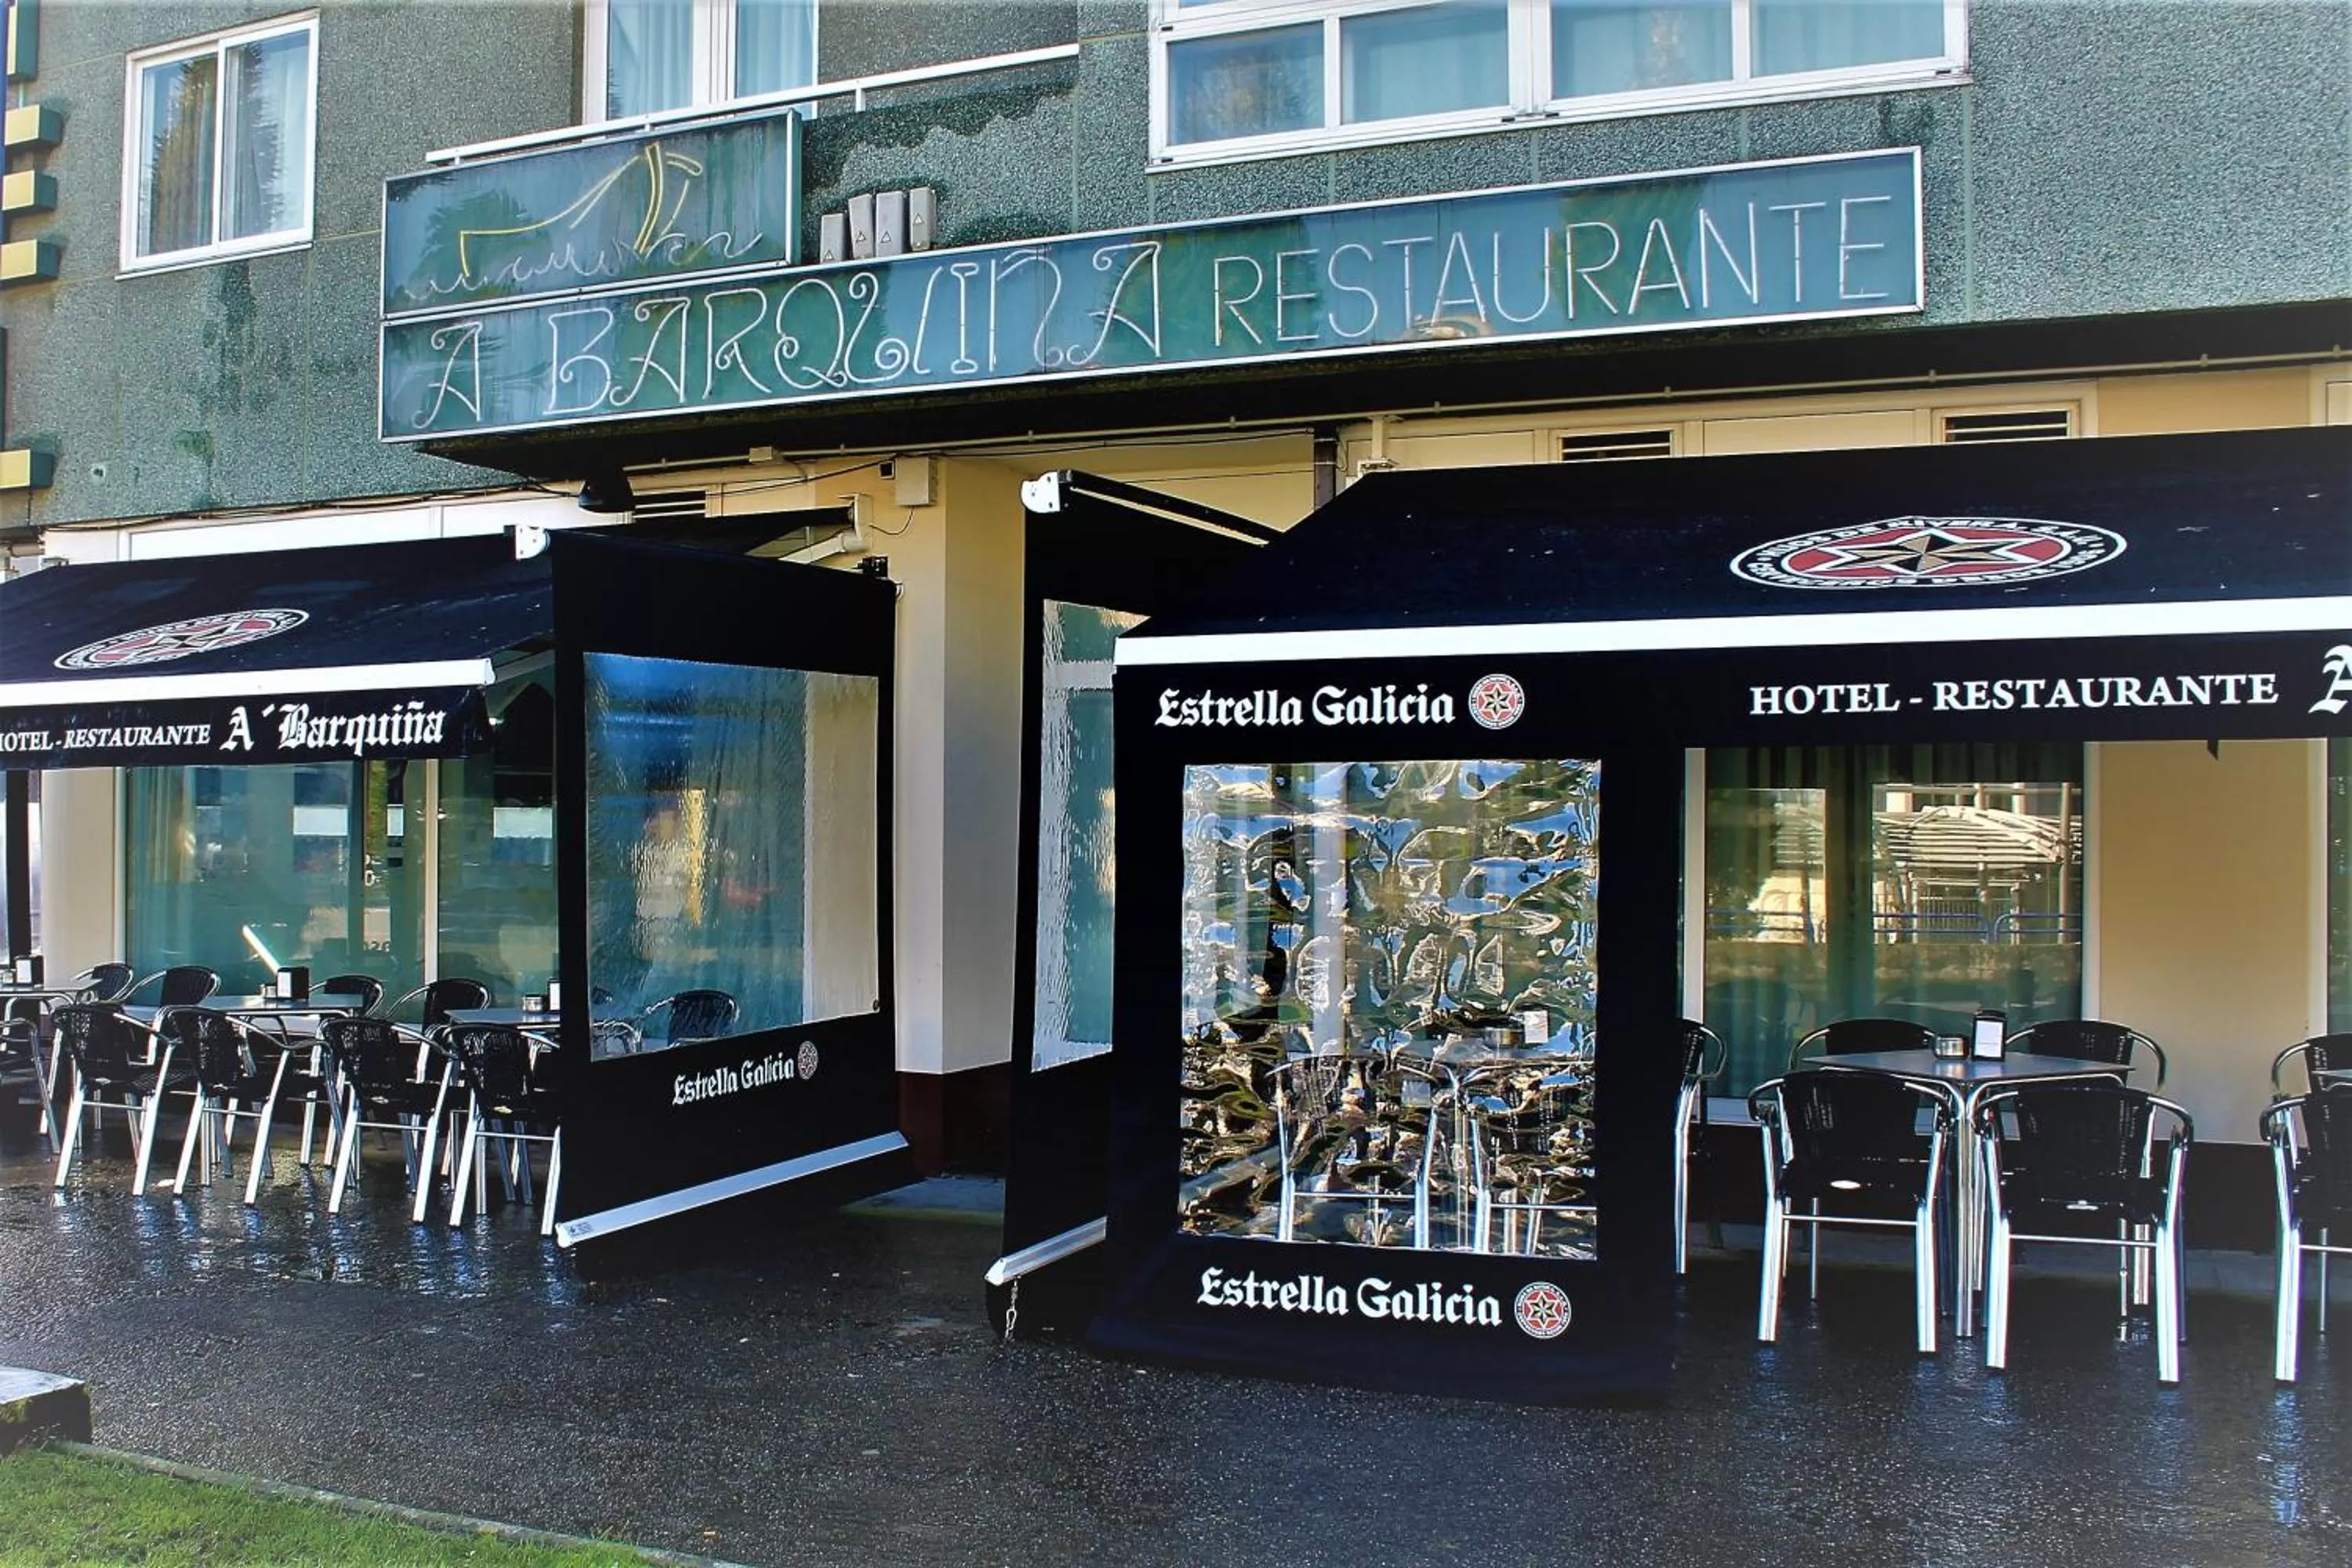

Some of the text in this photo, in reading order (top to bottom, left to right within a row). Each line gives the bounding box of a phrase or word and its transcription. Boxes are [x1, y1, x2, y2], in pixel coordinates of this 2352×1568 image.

[412, 321, 483, 430] A
[1215, 195, 1892, 347] RESTAURANTE
[1154, 688, 1304, 727] Estrella
[1312, 684, 1456, 726] Galicia
[1749, 684, 1900, 714] HOTEL
[1933, 673, 2279, 710] RESTAURANTE
[0, 731, 54, 752] OTEL
[672, 1067, 739, 1105] Estrella
[741, 1051, 794, 1089] Galicia
[1196, 1266, 1349, 1316] Estrella
[1356, 1277, 1503, 1327] Galicia
